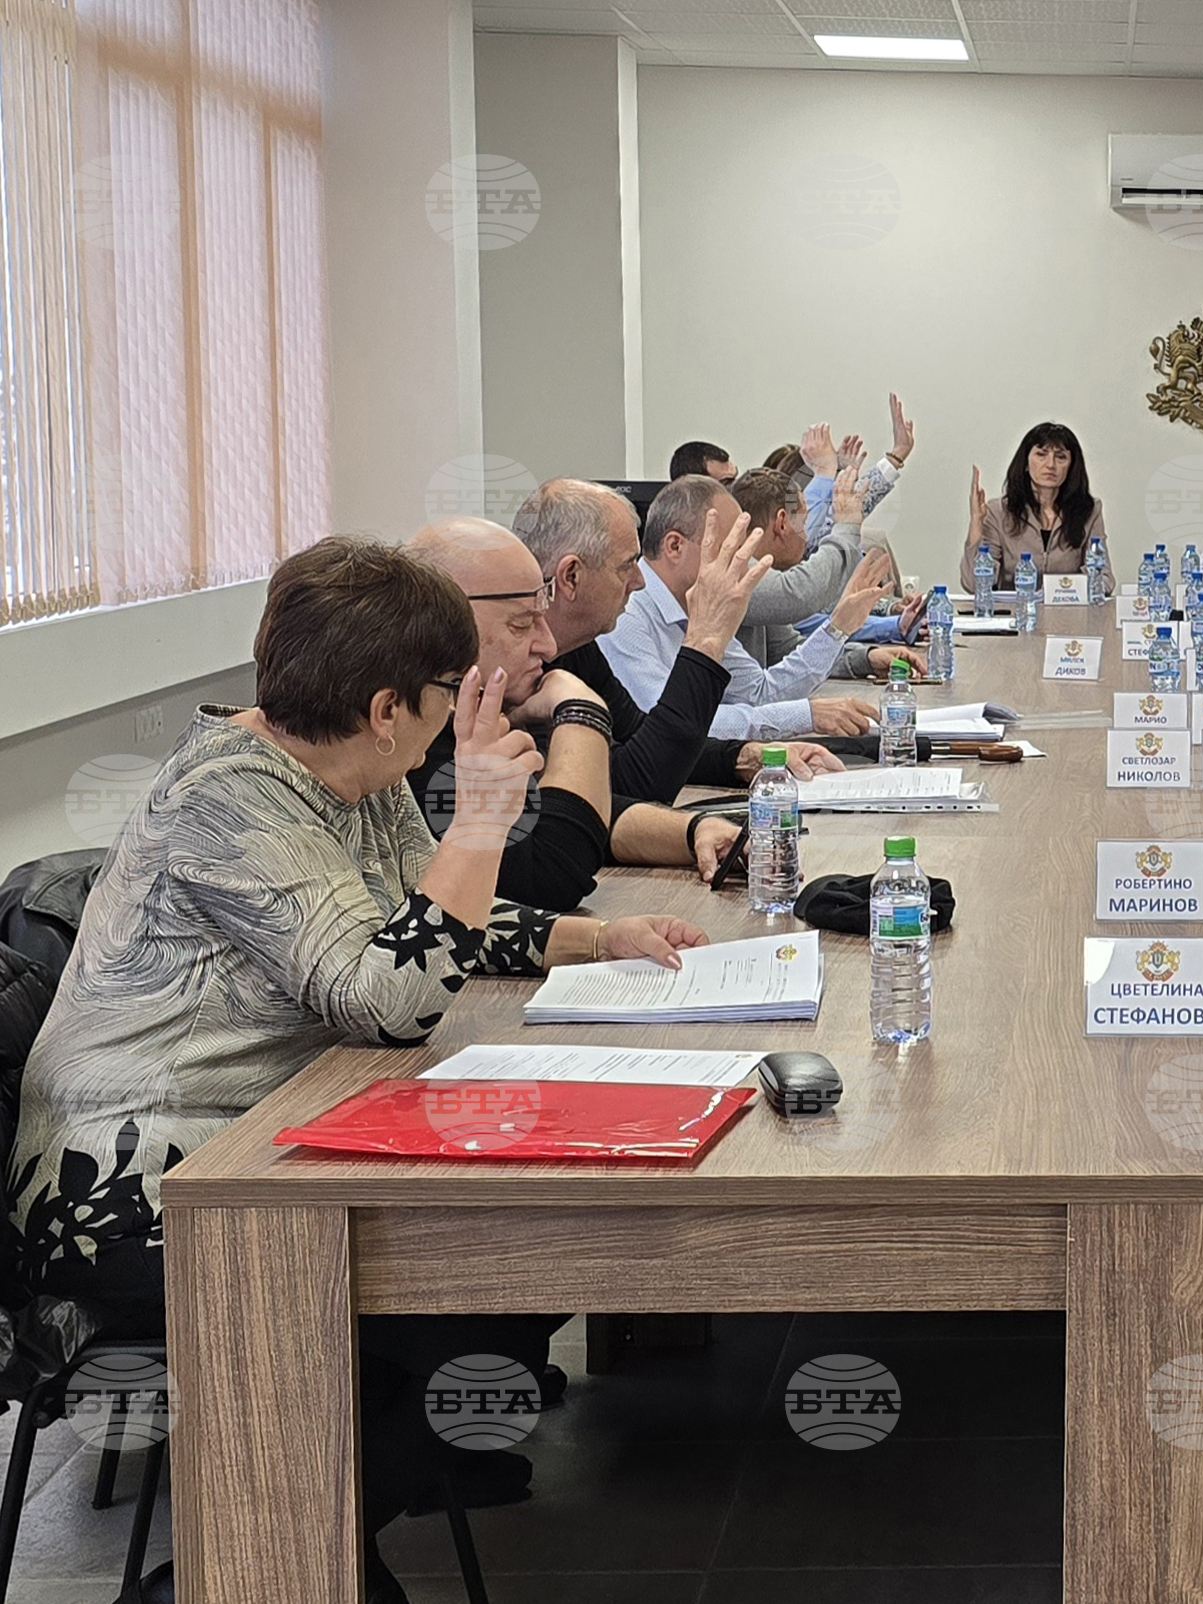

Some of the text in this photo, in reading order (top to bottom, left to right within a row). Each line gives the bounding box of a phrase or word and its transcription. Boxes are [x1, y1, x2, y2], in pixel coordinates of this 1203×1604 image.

[1121, 757, 1176, 766] СВЕТЛОЗАР
[1117, 771, 1181, 782] НИКОЛОВ
[1114, 878, 1192, 889] РОБЕРТИНО
[1109, 898, 1198, 912] МАРИНОВ
[1110, 984, 1203, 999] ЦВЕТЕЛИНА
